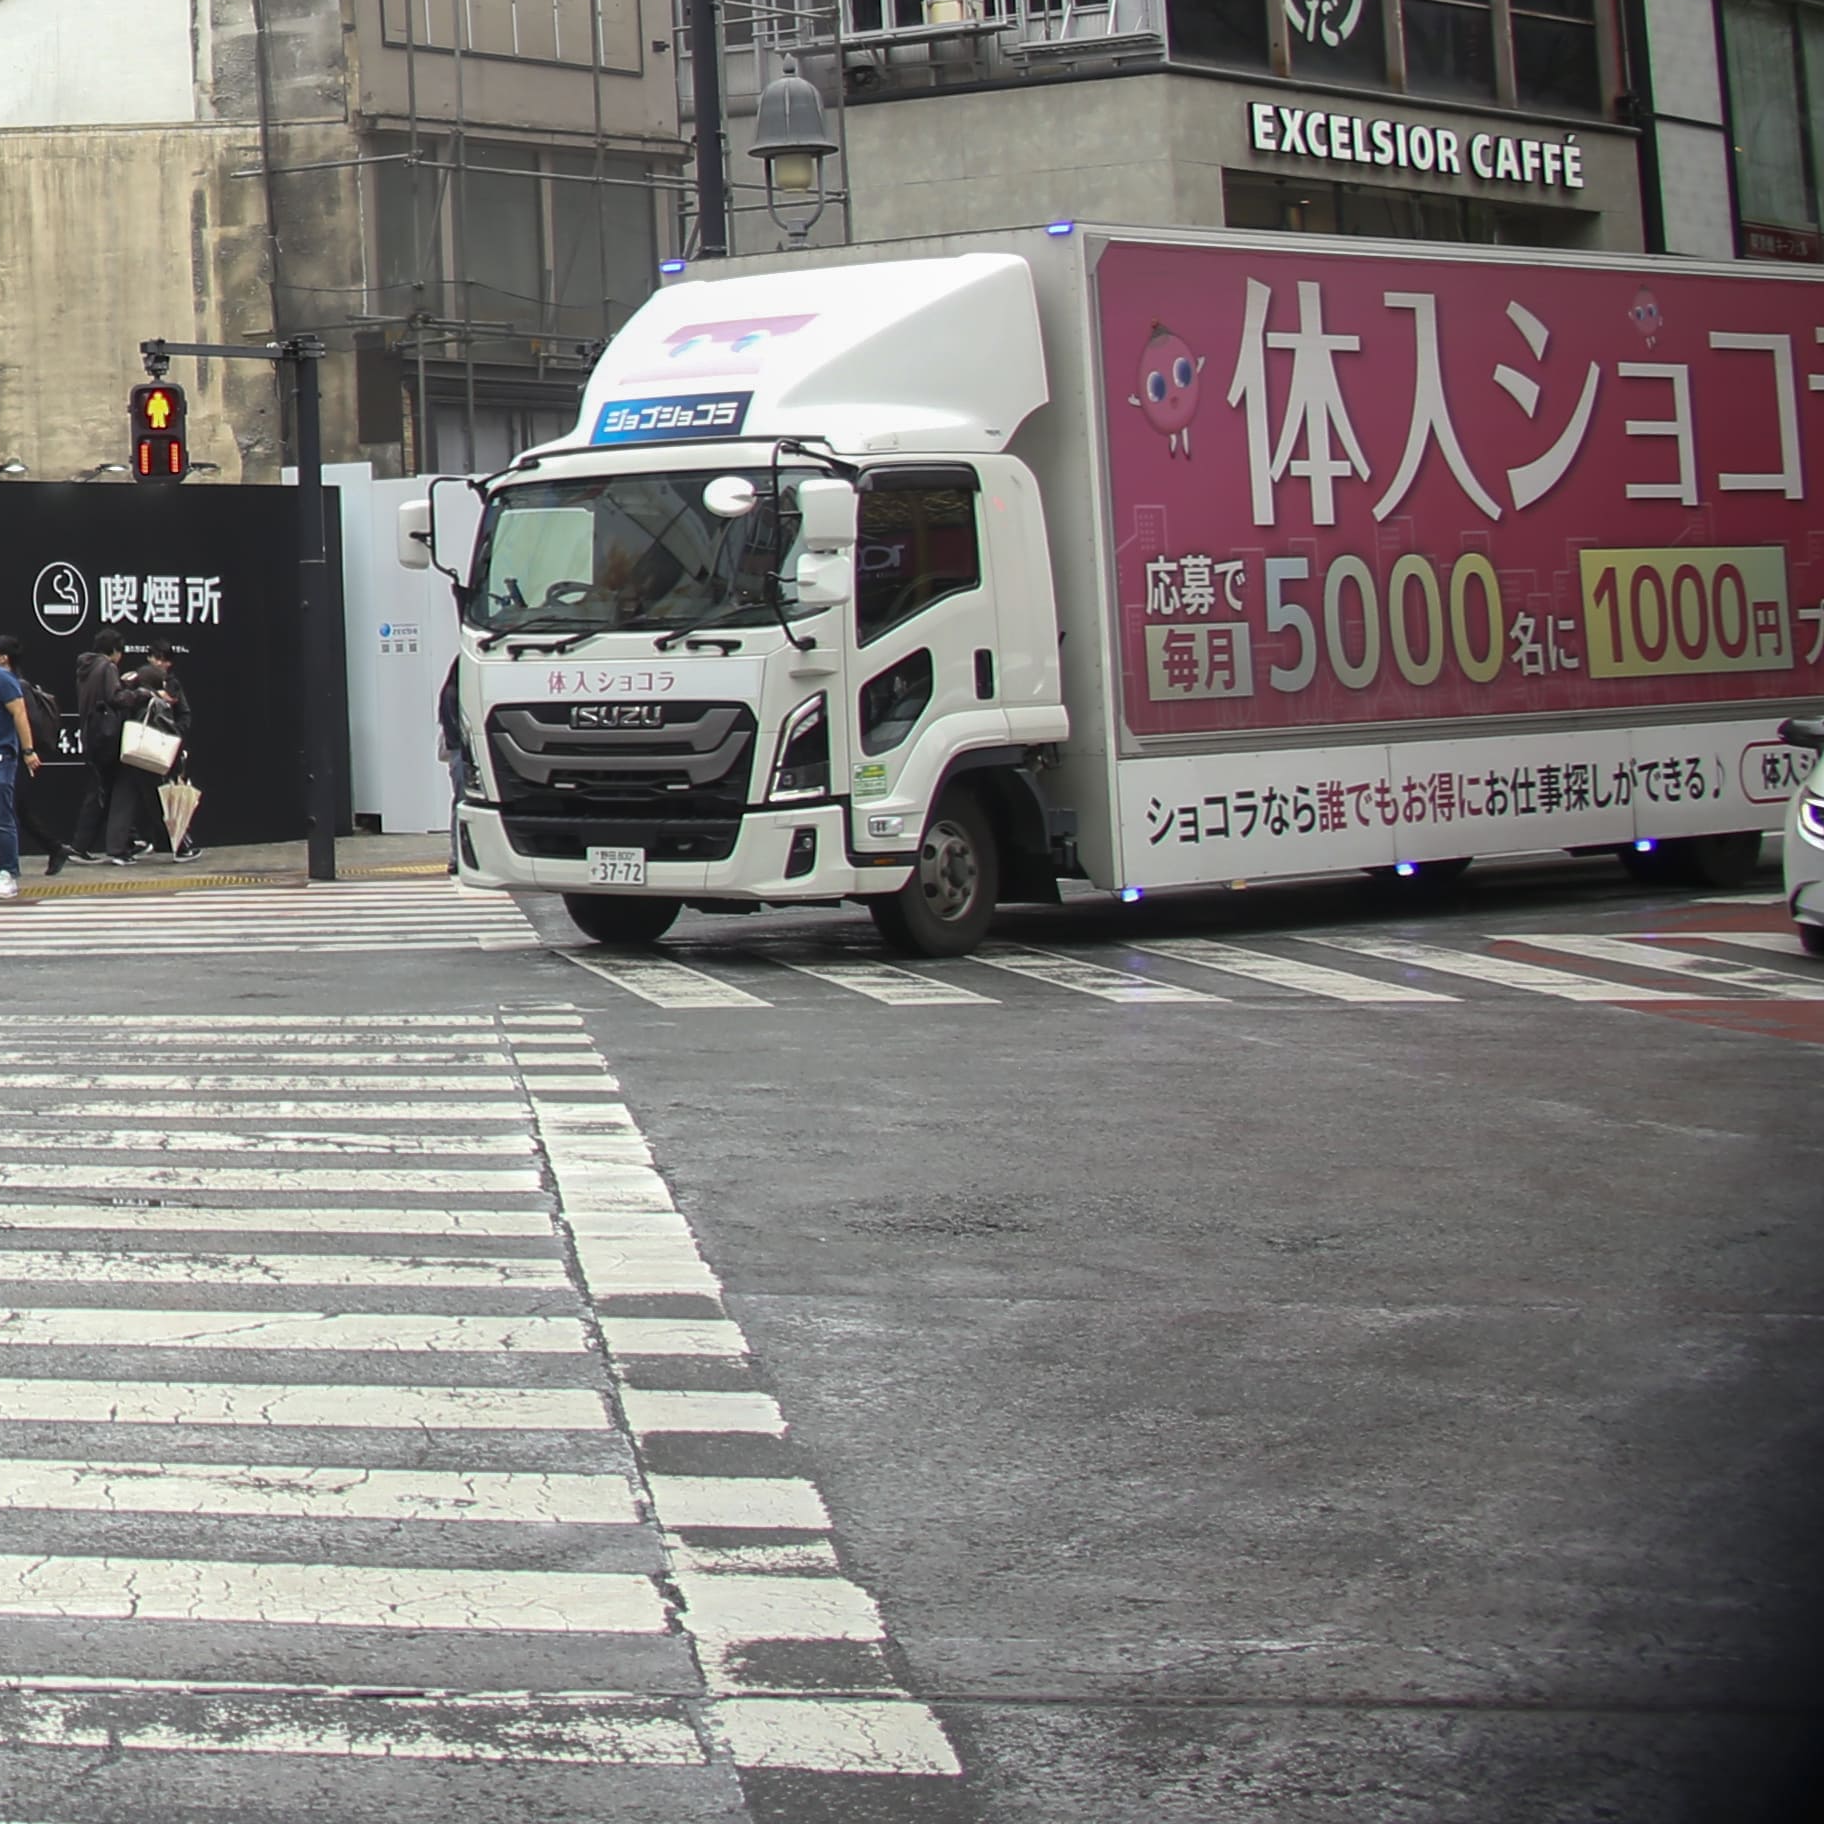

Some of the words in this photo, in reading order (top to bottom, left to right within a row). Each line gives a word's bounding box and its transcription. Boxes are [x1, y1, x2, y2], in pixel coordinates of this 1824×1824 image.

[1249, 100, 1461, 175] EXCELSIOR
[1226, 276, 1824, 527] 体入ショコ
[99, 574, 223, 626] 喫煙所
[1145, 554, 1247, 616] 応募で
[1265, 552, 1581, 694] 5000名に
[1592, 562, 1784, 665] 1000円
[546, 669, 677, 696] 体入ショコラ
[1161, 628, 1241, 695] 毎月
[569, 704, 662, 728] ISUZU
[599, 862, 642, 882] 37-72
